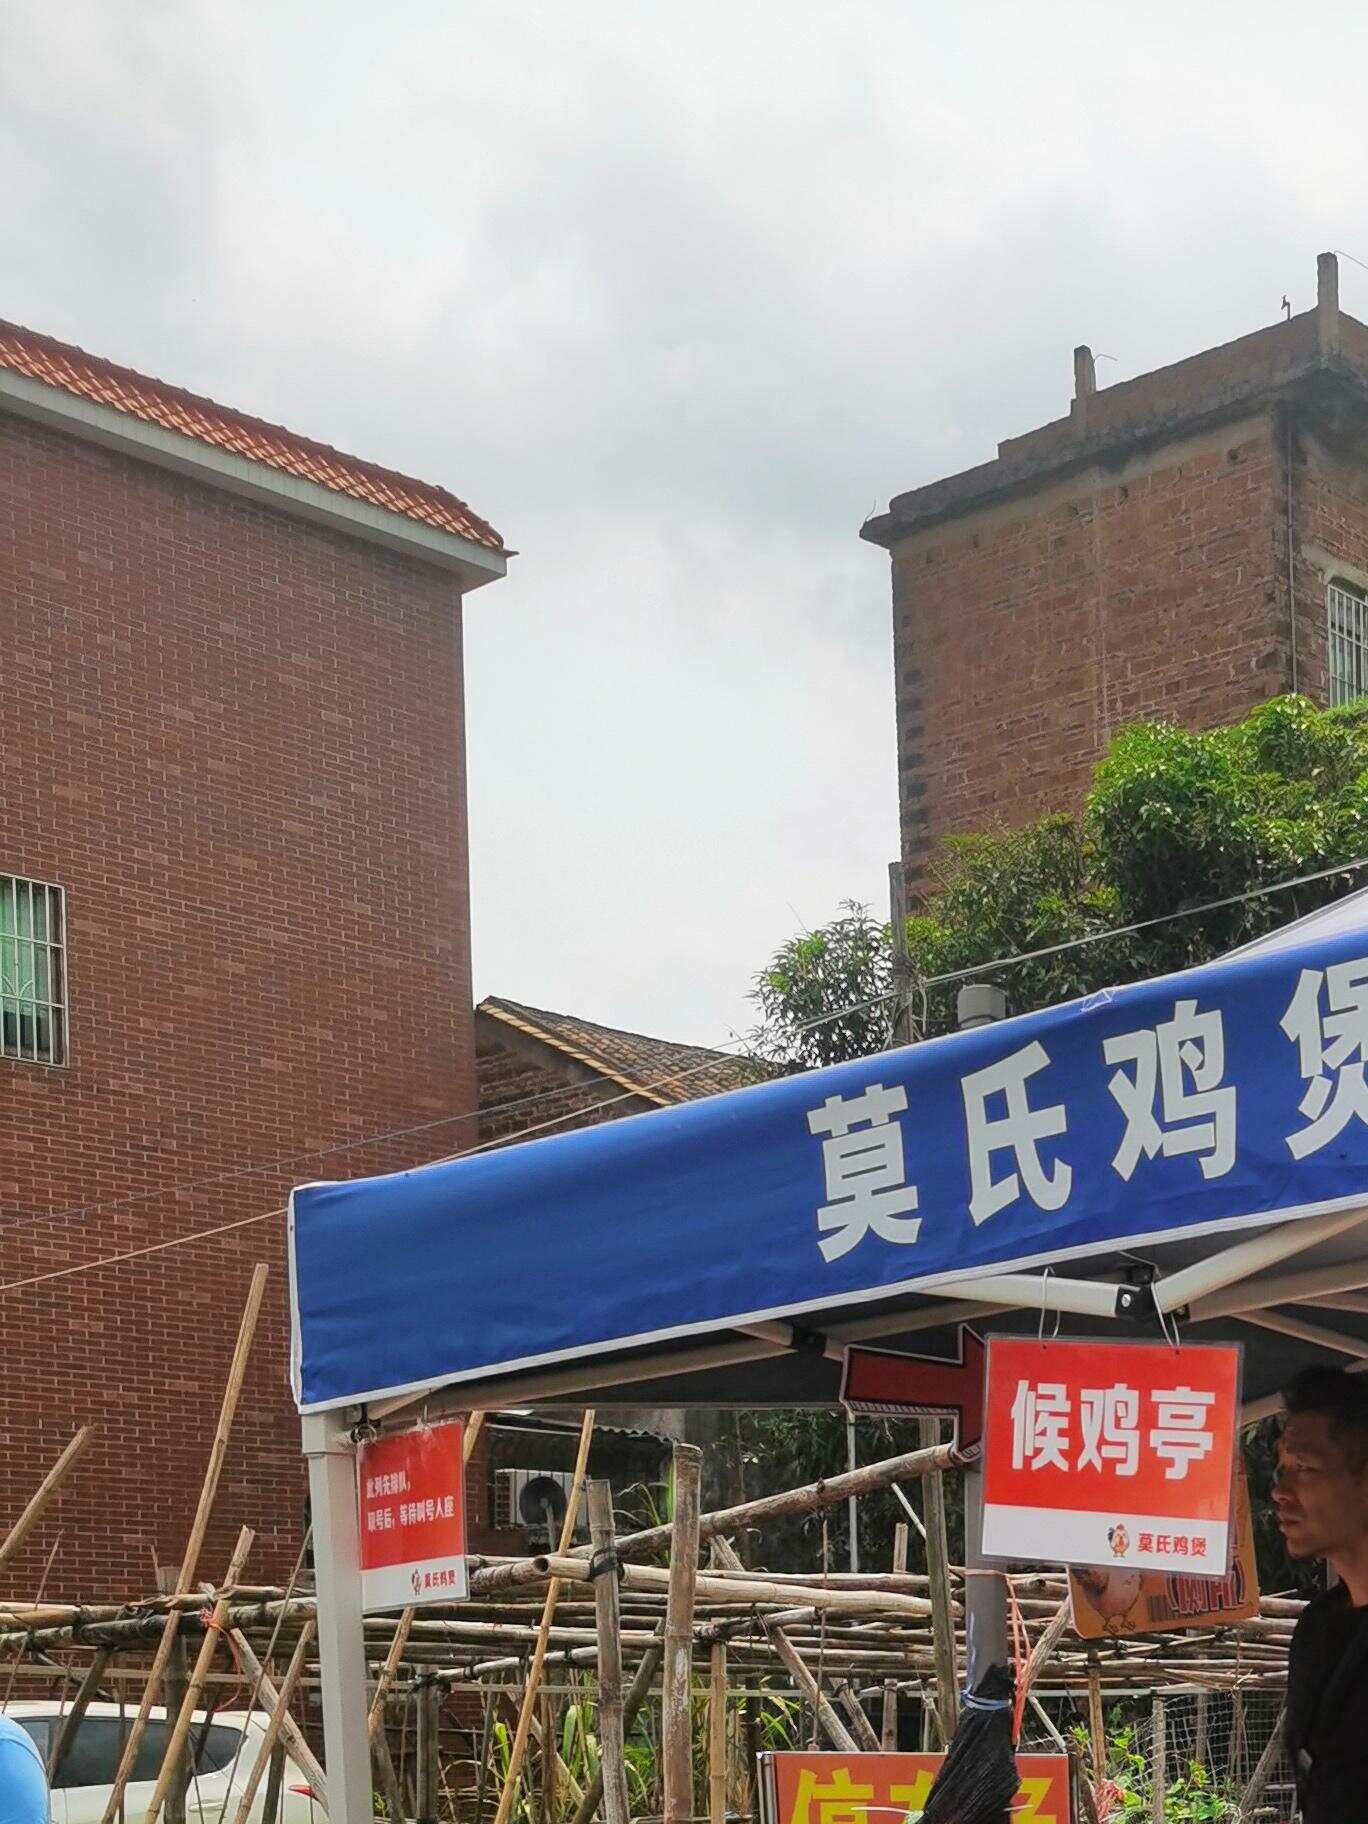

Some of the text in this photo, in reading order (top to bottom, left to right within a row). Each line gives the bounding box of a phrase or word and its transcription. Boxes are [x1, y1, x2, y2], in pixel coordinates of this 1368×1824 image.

[1010, 1379, 1217, 1480] 候鸡亭
[1138, 1533, 1207, 1557] 莫氏鸡煲
